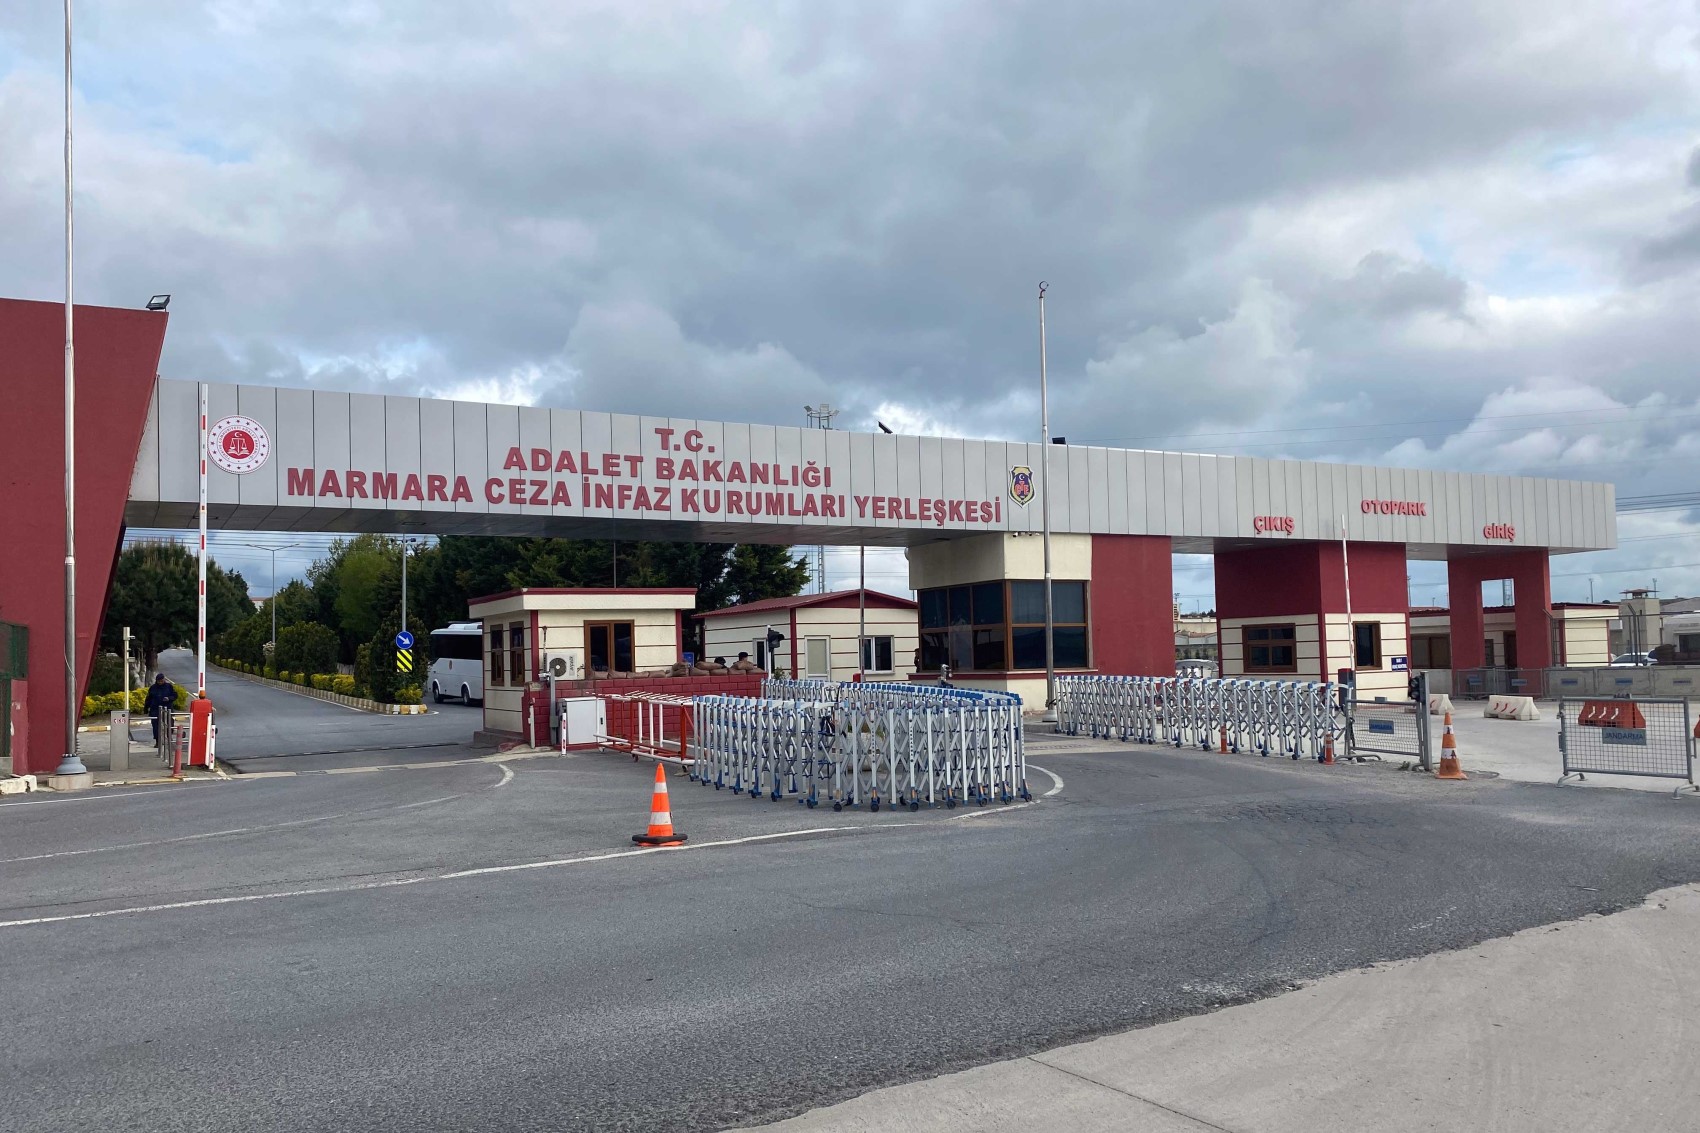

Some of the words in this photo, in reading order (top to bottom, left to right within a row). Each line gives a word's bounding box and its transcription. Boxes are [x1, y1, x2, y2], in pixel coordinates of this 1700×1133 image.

[655, 428, 715, 452] T.C.
[504, 447, 643, 477] ADALET
[655, 457, 831, 487] BAKANLIĞI
[288, 468, 473, 502] MARMARA
[485, 478, 571, 506] CEZA
[583, 476, 671, 512] İNFAZ
[681, 488, 845, 517] KURUMLARI
[853, 496, 1001, 526] YERLEŞKESİ
[1361, 499, 1427, 516] OTOPARK
[1253, 515, 1296, 536] ÇIKIŞ
[1483, 522, 1515, 543] GİRİŞ
[1604, 732, 1644, 740] JANDARMA
